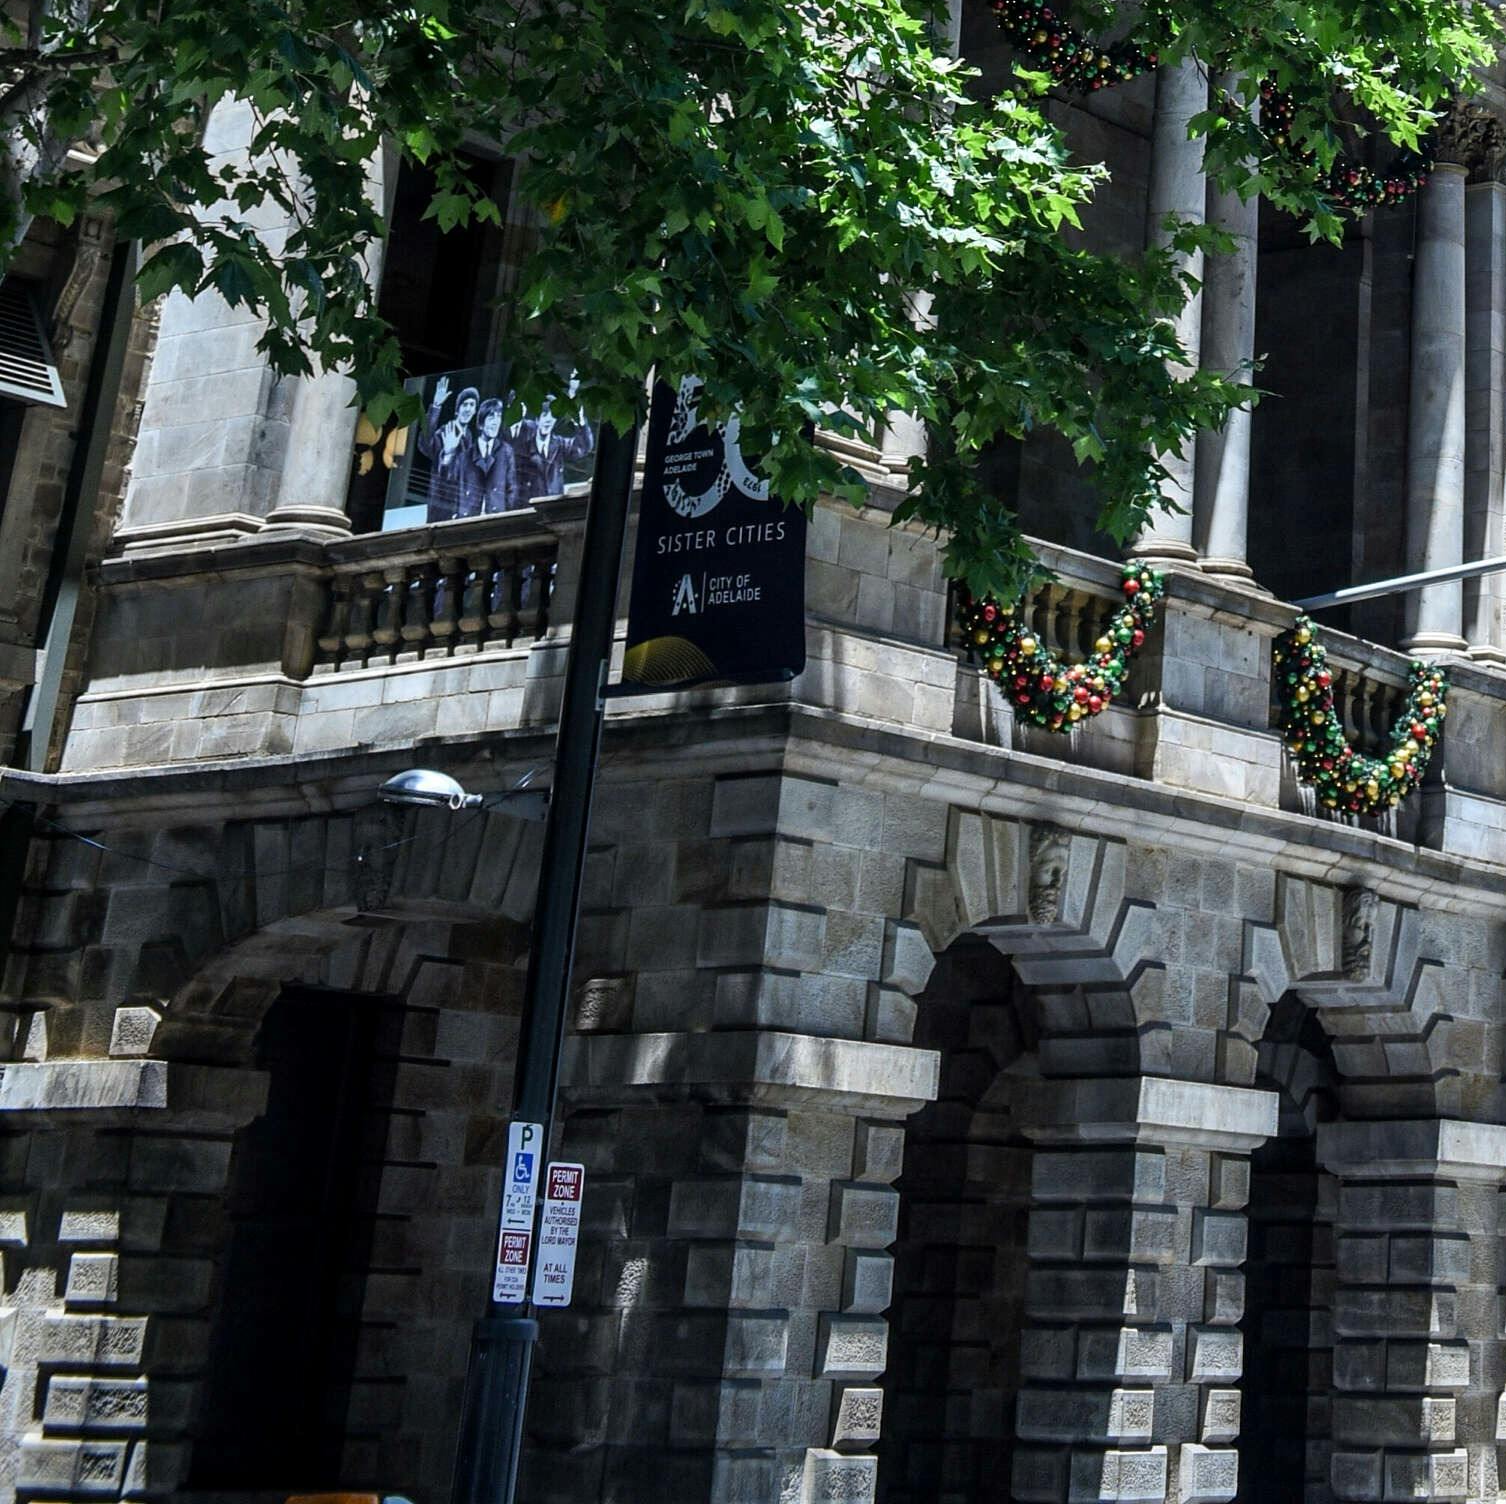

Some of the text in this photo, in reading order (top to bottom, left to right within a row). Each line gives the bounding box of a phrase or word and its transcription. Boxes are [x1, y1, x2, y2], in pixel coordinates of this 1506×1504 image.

[664, 449, 714, 464] GEORGE TOWN
[664, 462, 697, 475] ADELAIDE
[657, 521, 785, 554] SISTER CITIES
[708, 574, 750, 591] CITY OF
[707, 587, 761, 605] ADELAIDE
[521, 1125, 533, 1150] P
[552, 1169, 579, 1184] PERMIT
[512, 1184, 530, 1194] ONLY
[553, 1185, 575, 1199] ZONE
[549, 1206, 576, 1216] VEHICLES
[544, 1216, 578, 1226] AUTHORISED
[550, 1226, 570, 1236] BY THE
[504, 1235, 527, 1249] PERMIT
[504, 1249, 524, 1263] ZONE
[543, 1263, 567, 1274] AT ALL
[544, 1274, 565, 1284] TIMES
